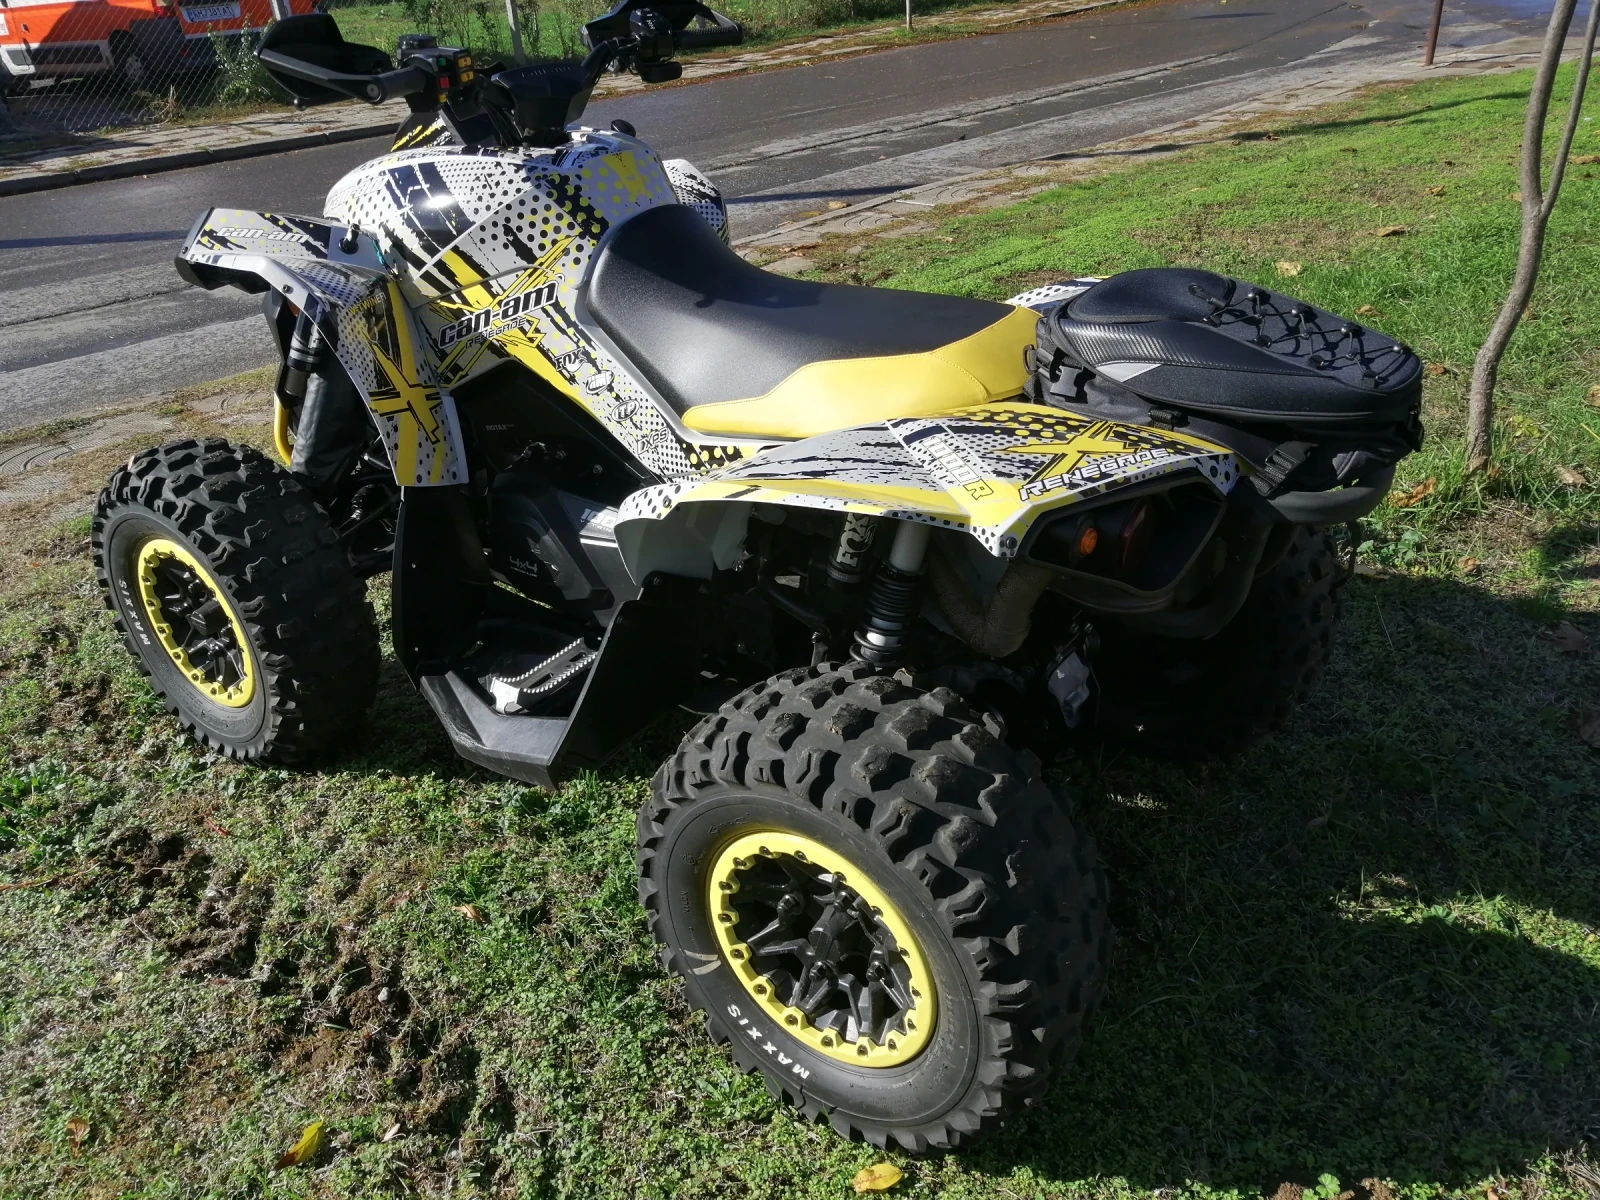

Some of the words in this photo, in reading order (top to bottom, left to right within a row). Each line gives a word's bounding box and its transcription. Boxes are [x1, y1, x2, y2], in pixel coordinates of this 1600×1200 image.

[216, 226, 310, 243] can-am
[438, 280, 560, 349] can-am
[465, 317, 528, 350] RENEGADE
[555, 348, 586, 372] FOX
[614, 402, 635, 420] ITP
[921, 435, 994, 501] 1000R
[1018, 446, 1171, 502] RENEGADE
[509, 555, 538, 573] 4x4
[836, 512, 870, 567] FOX
[118, 578, 151, 646] MAXXIS
[727, 1003, 810, 1080] MAXXIS
